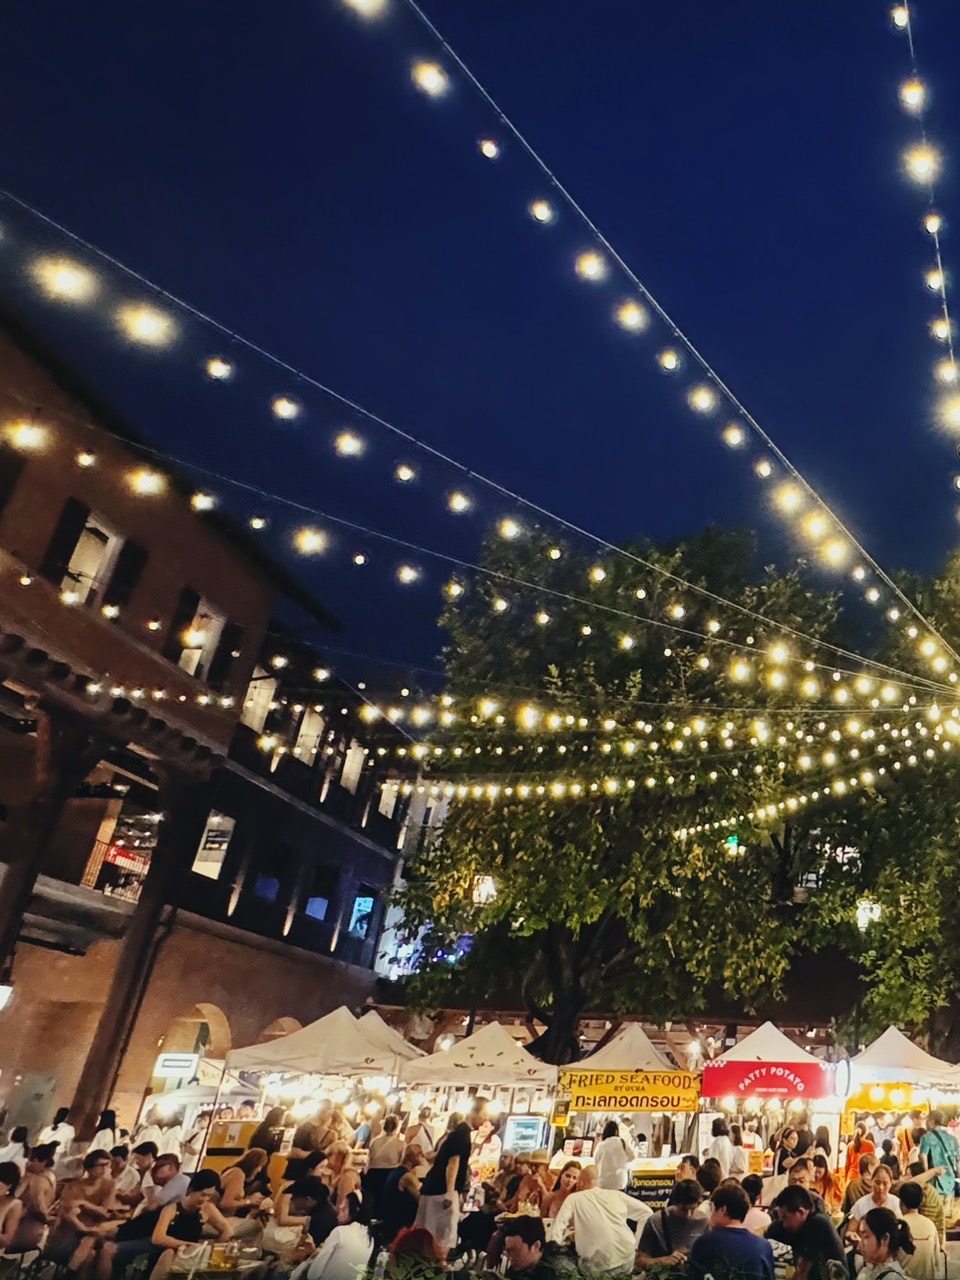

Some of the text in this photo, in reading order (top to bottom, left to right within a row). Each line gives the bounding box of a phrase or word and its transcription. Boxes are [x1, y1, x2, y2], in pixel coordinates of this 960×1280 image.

[569, 1073, 692, 1090] FRIED SEAFOOD
[738, 1066, 805, 1091] PATTY POTATO
[574, 1095, 681, 1108] ทะเลทอดกรอบ
